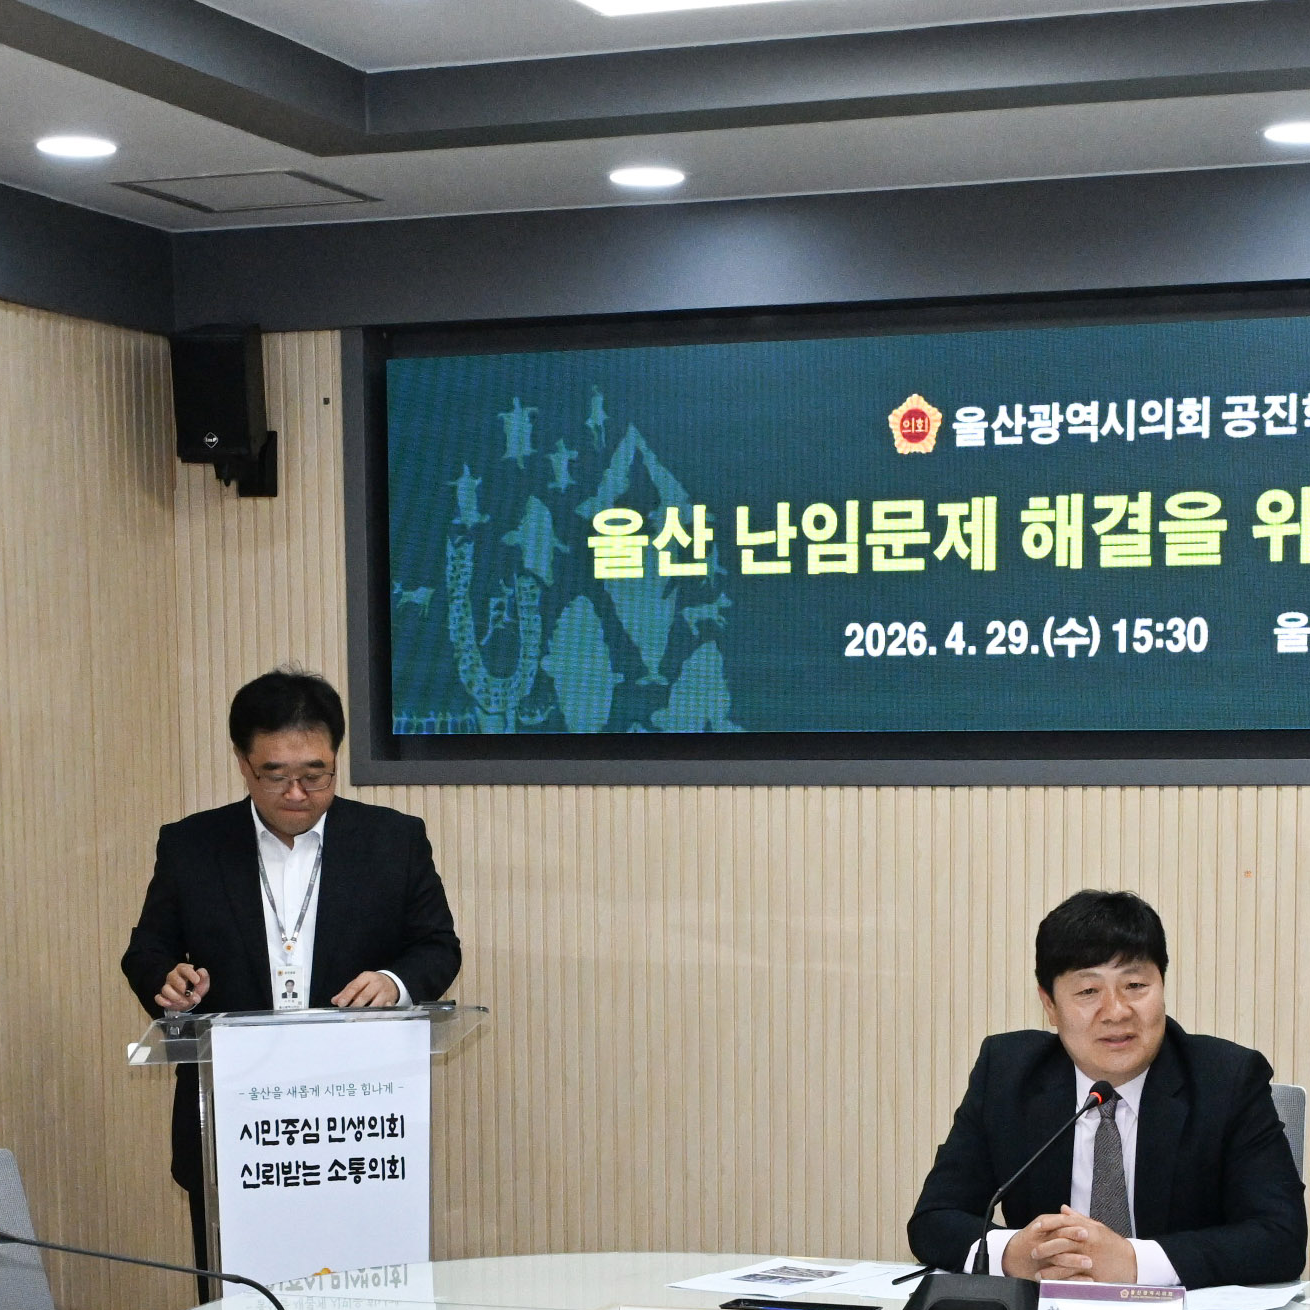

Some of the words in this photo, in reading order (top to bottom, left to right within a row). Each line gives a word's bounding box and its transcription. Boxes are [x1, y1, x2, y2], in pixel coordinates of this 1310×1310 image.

[952, 396, 1211, 449] 울산광역시의회
[587, 503, 714, 580] 울산
[736, 495, 998, 576] 난임문제
[1020, 490, 1228, 571] 해결을
[844, 621, 937, 657] 2026.
[944, 621, 977, 656] 4.
[985, 615, 1101, 660] 29.(수)
[1111, 616, 1209, 655] 15:30
[248, 1086, 283, 1100] 울산을
[286, 1085, 320, 1099] 새롭게
[324, 1083, 357, 1097] 시민을
[360, 1082, 393, 1096] 힘나게
[239, 1117, 320, 1147] 시민중심
[327, 1112, 405, 1143] 민생의회
[240, 1160, 321, 1190] 신뢰받는
[327, 1154, 406, 1185] 소통의회
